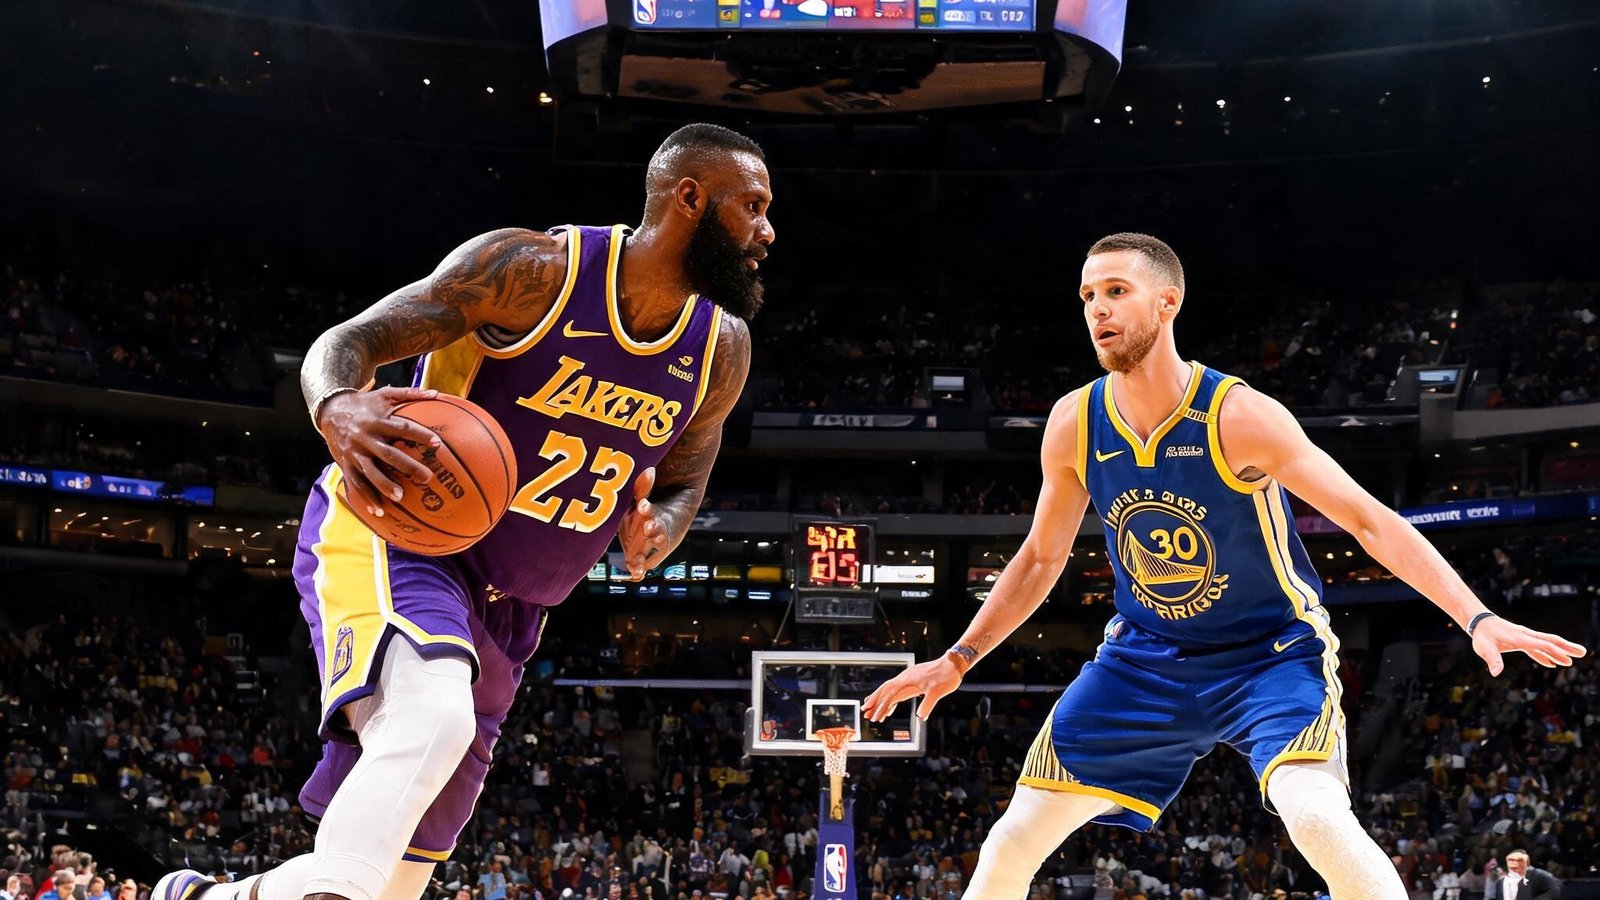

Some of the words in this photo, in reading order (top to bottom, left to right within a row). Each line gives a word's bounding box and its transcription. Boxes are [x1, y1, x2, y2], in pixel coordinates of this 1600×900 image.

[515, 355, 682, 447] LAKERS
[508, 430, 635, 533] 23
[1150, 526, 1198, 561] 30
